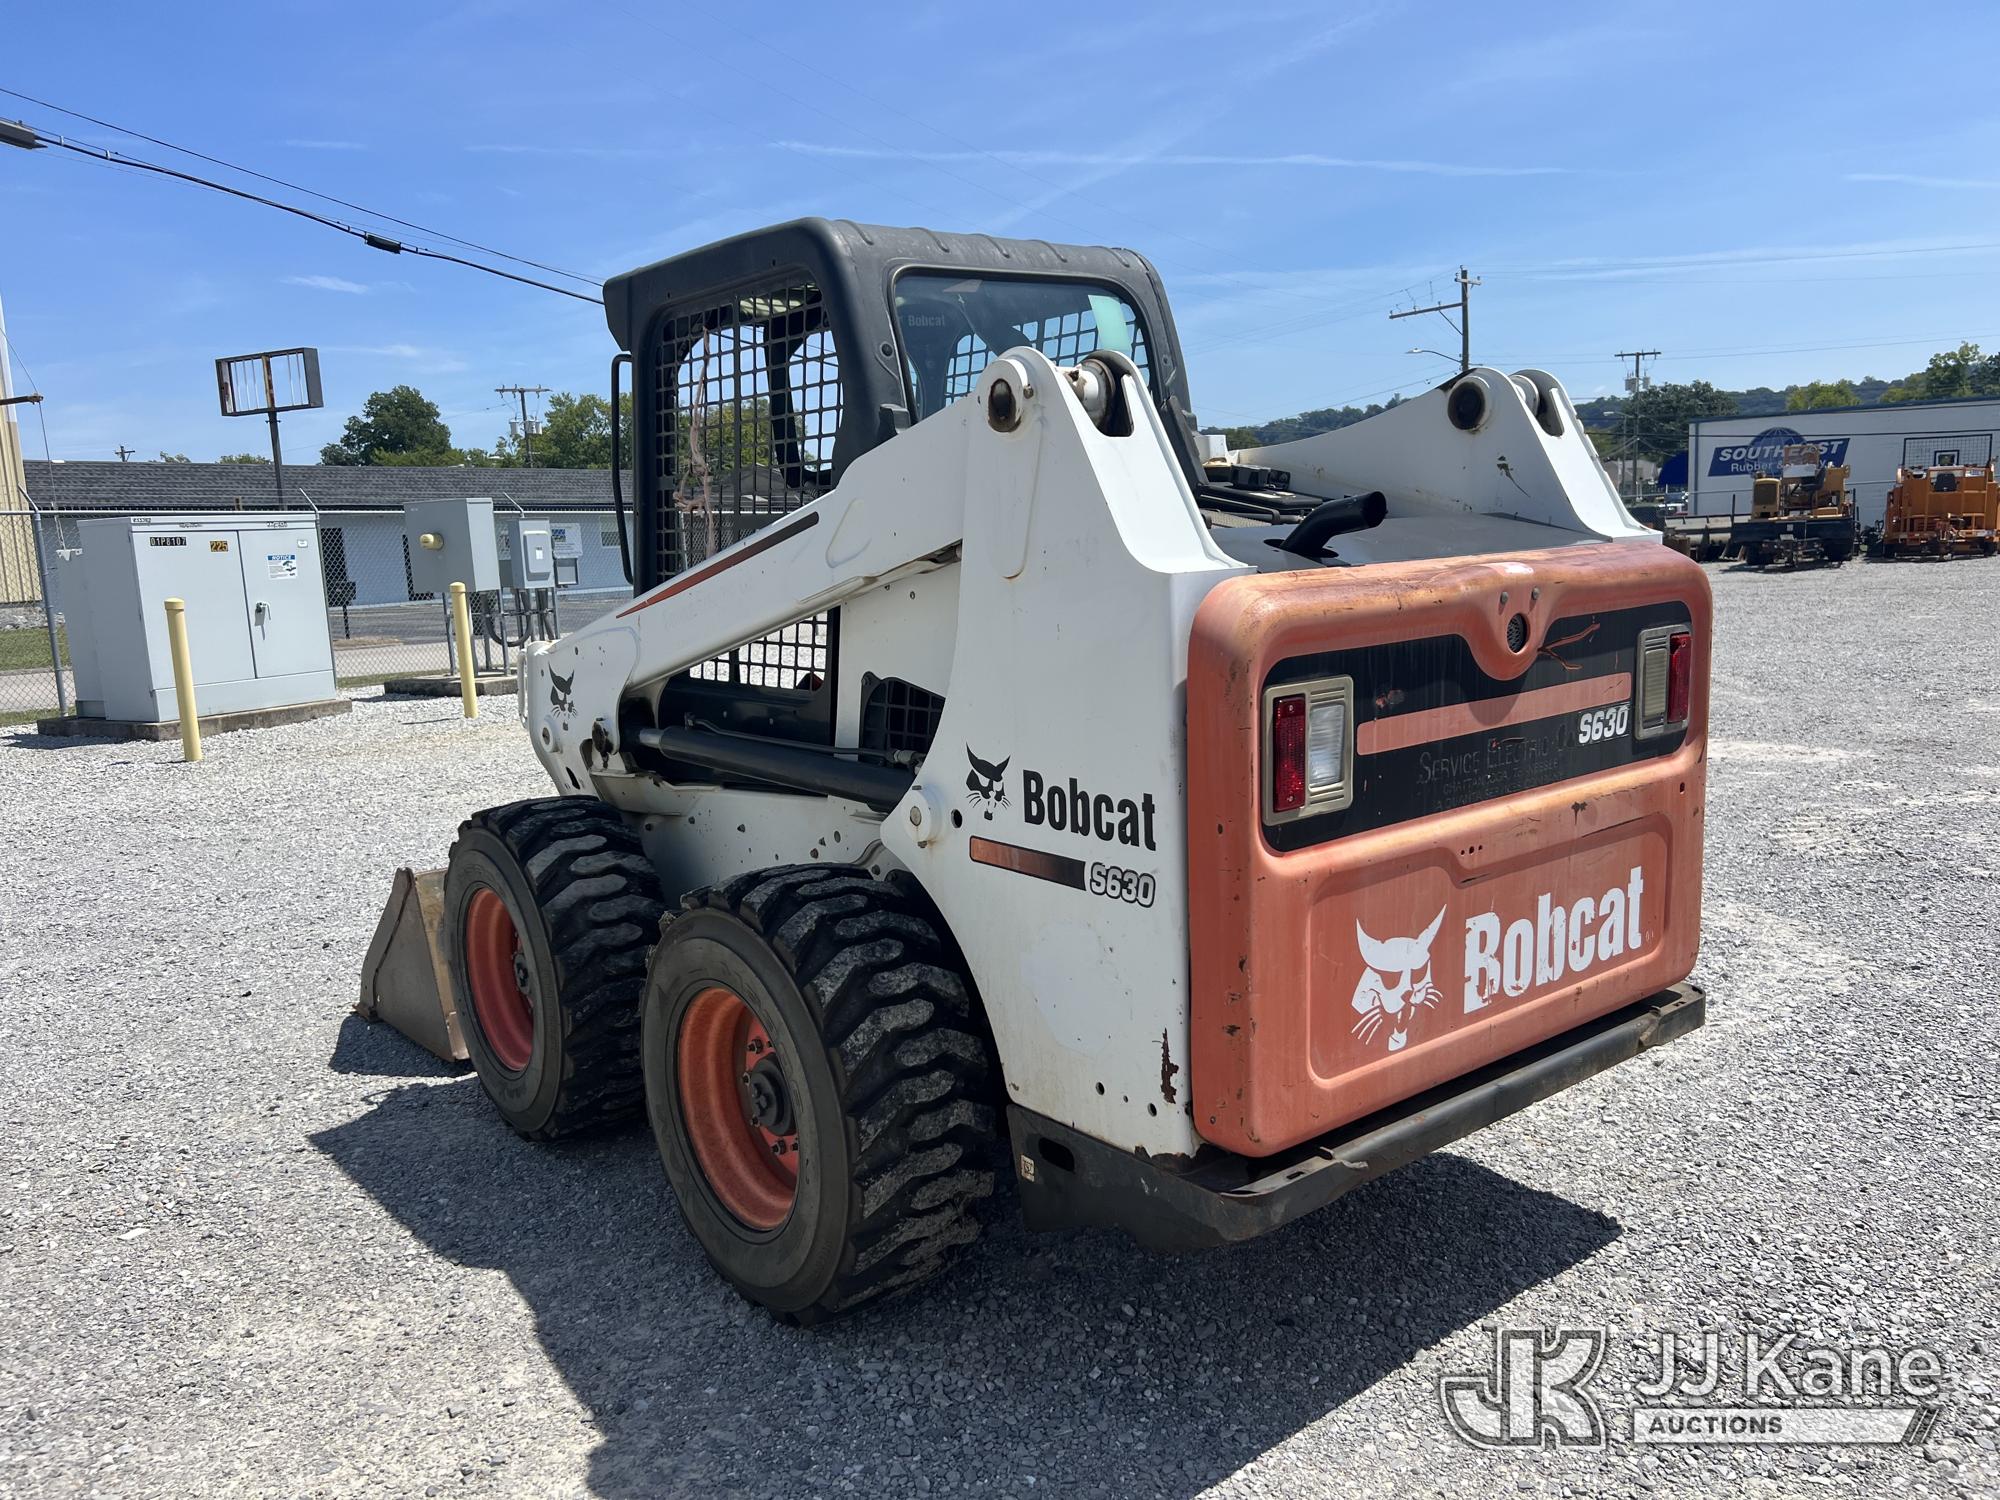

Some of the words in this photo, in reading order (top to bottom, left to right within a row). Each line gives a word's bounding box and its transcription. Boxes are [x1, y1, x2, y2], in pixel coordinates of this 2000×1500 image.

[908, 314, 945, 327] Bobcat
[1730, 461, 1772, 473] Rubber
[150, 536, 187, 546] 01P8107
[210, 541, 228, 552] 225
[1577, 704, 1630, 745] S630
[1022, 769, 1157, 852] Bobcat
[1089, 861, 1156, 909] S630
[1463, 865, 1644, 1015] Bobcat
